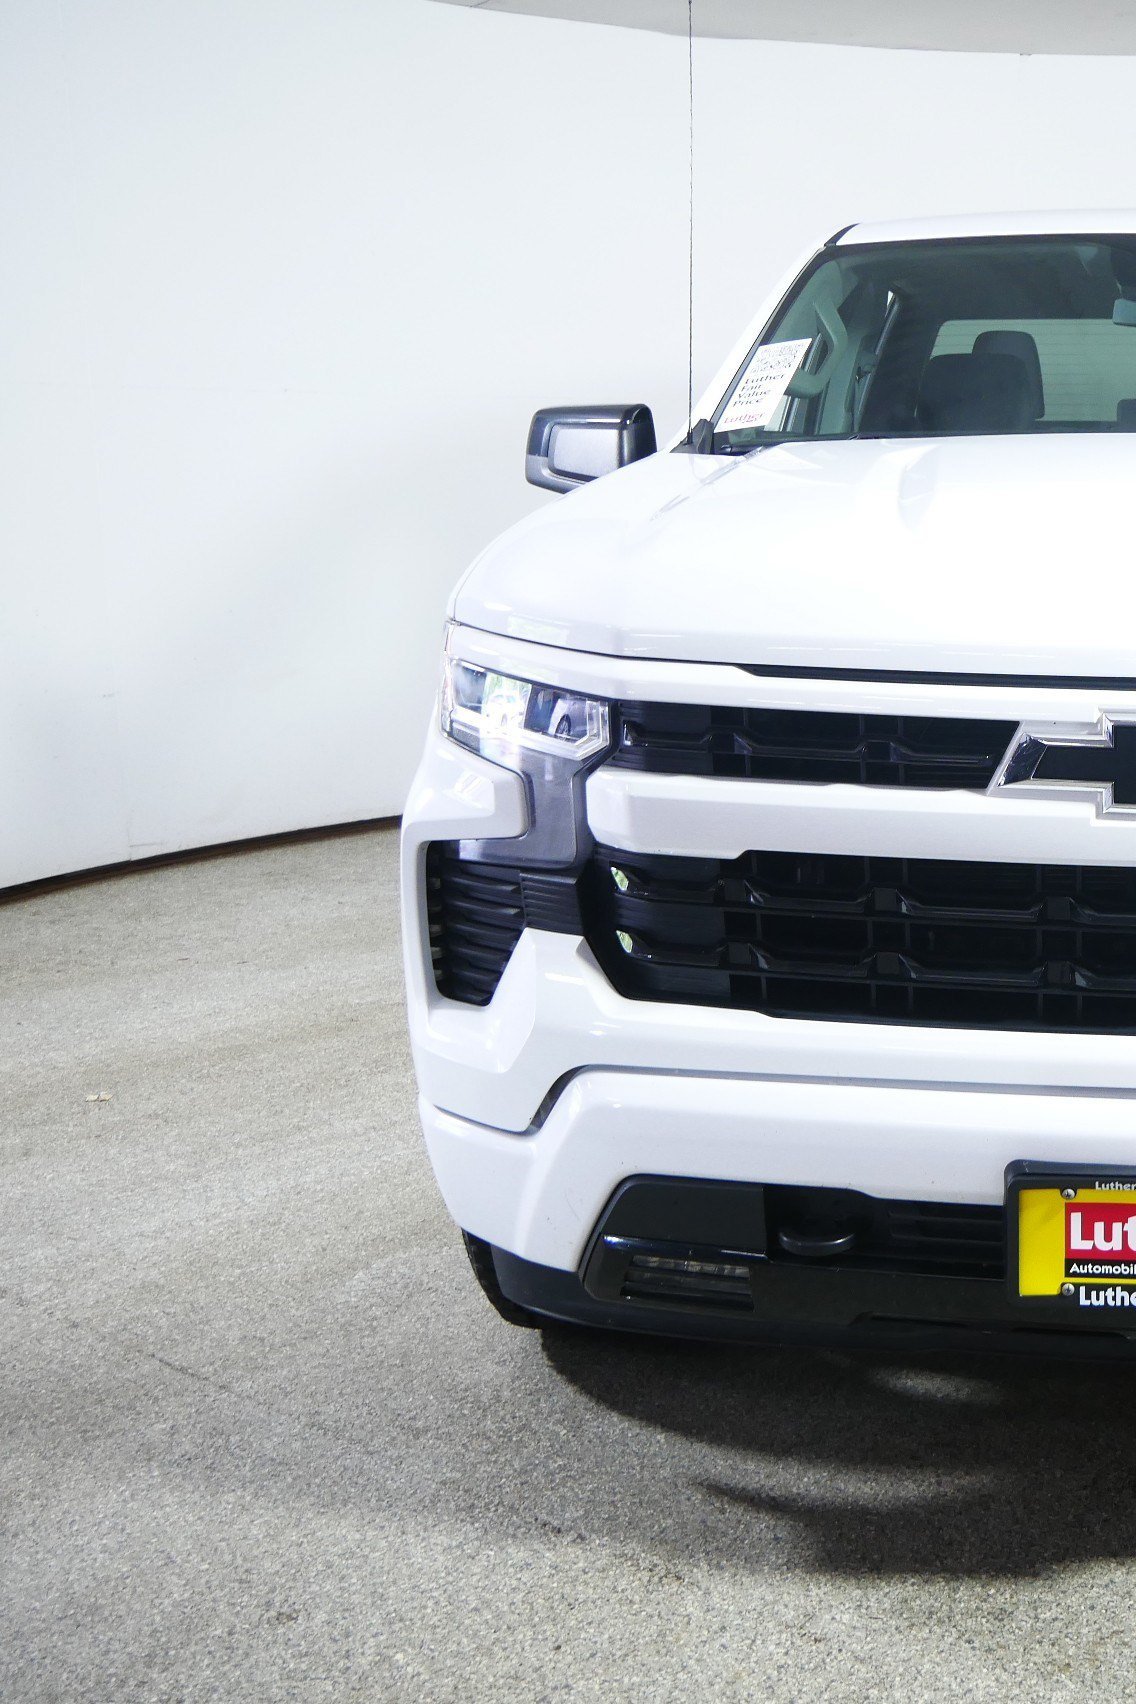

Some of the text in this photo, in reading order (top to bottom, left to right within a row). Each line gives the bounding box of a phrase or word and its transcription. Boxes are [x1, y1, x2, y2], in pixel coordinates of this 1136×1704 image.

[745, 374, 784, 385] Luther
[737, 390, 771, 399] Value
[733, 398, 763, 407] Price
